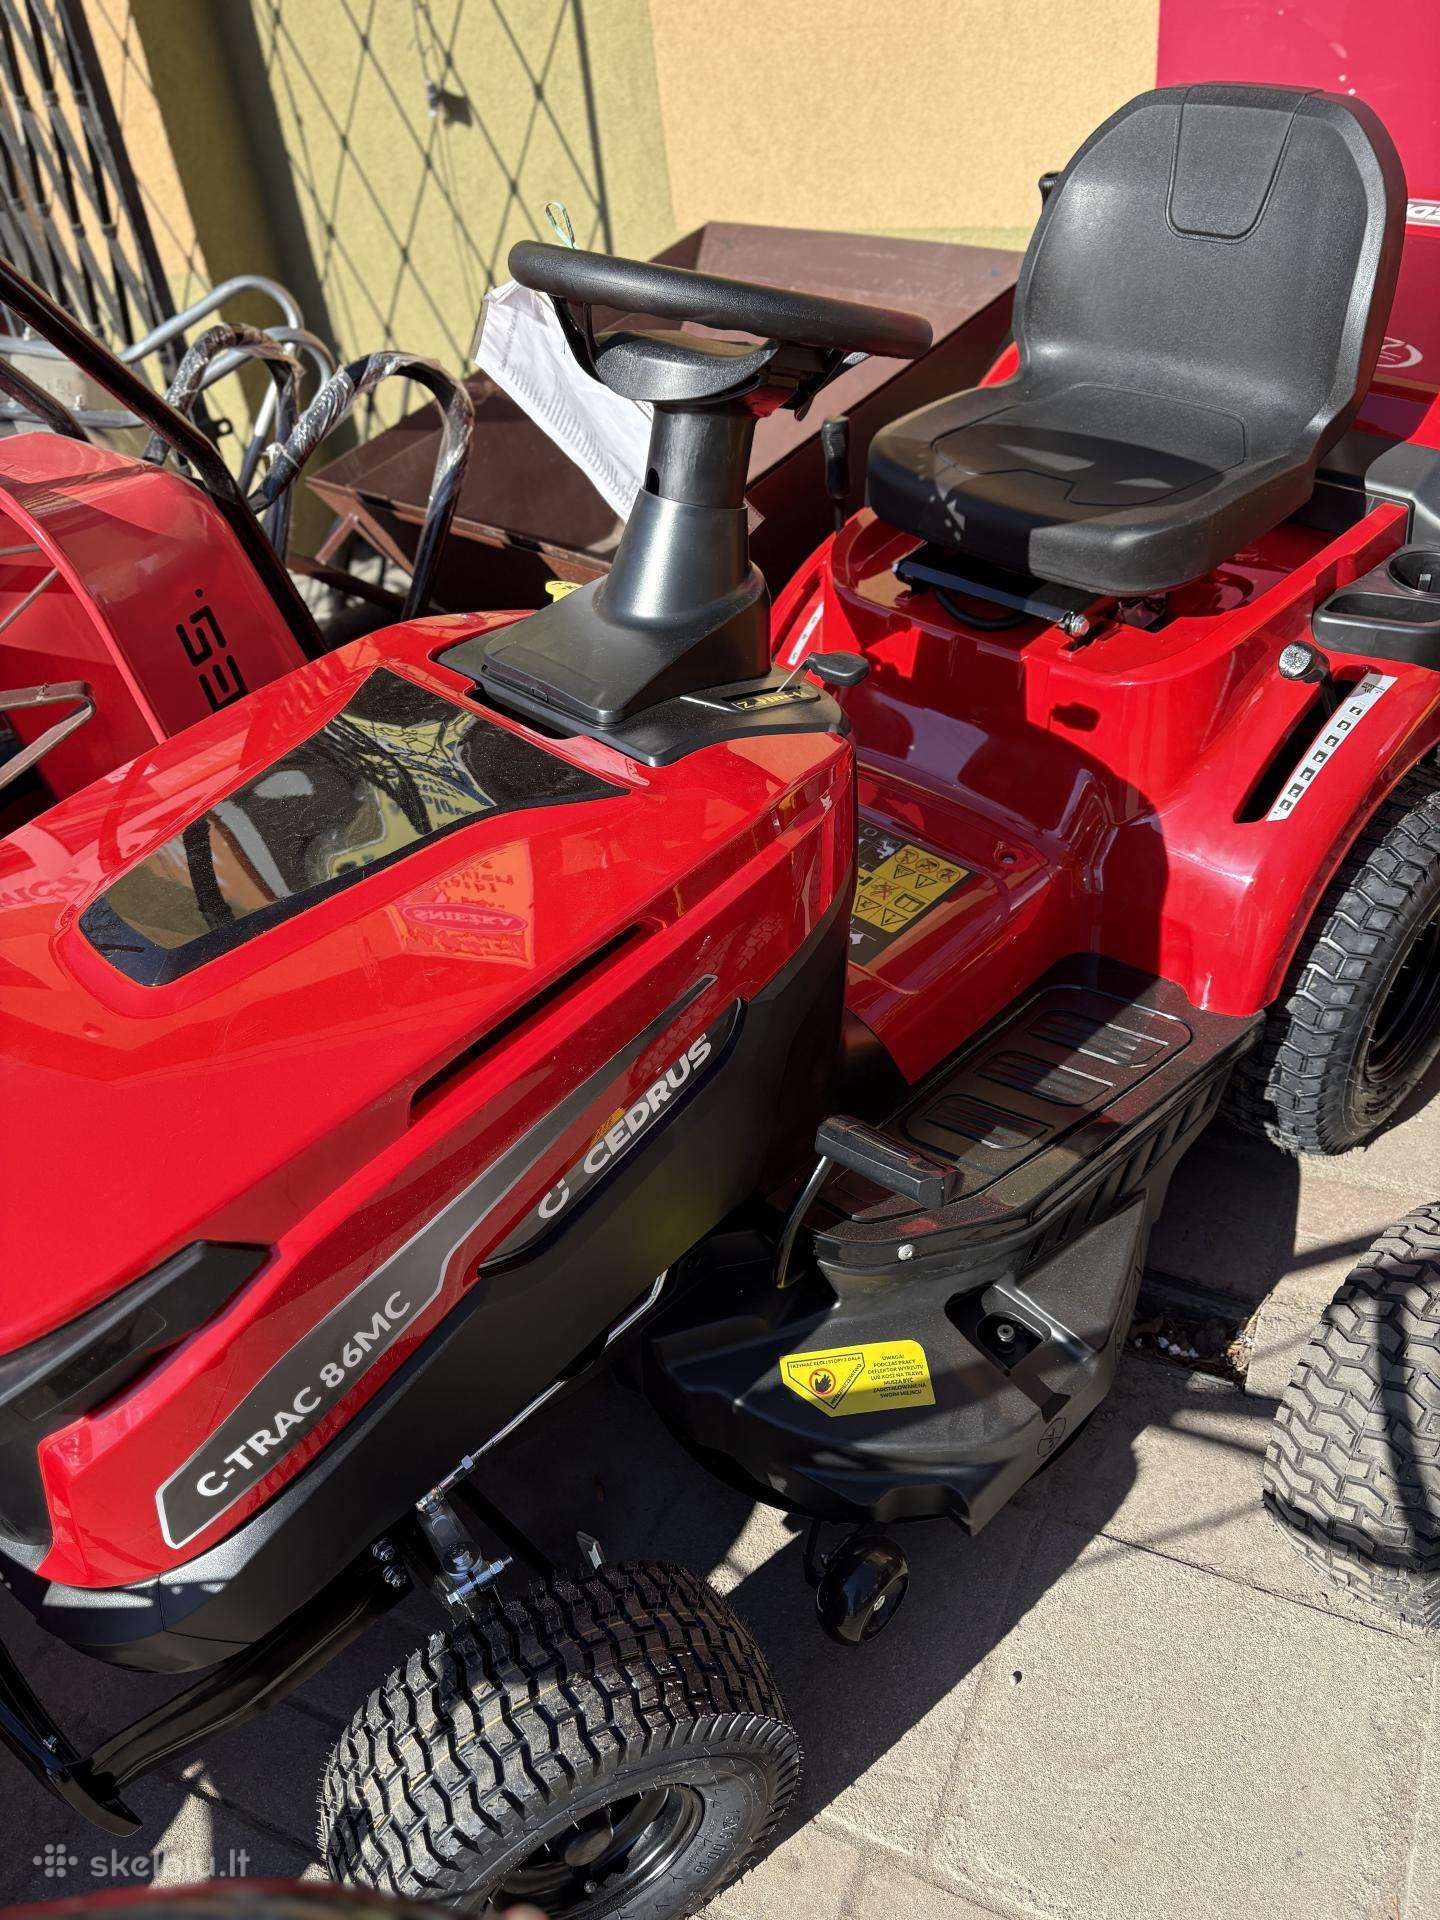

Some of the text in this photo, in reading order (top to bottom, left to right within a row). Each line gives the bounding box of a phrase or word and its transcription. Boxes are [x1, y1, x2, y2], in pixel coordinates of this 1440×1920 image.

[584, 1033, 711, 1173] CEDRUS
[197, 1291, 410, 1497] C-TRAC 86MC
